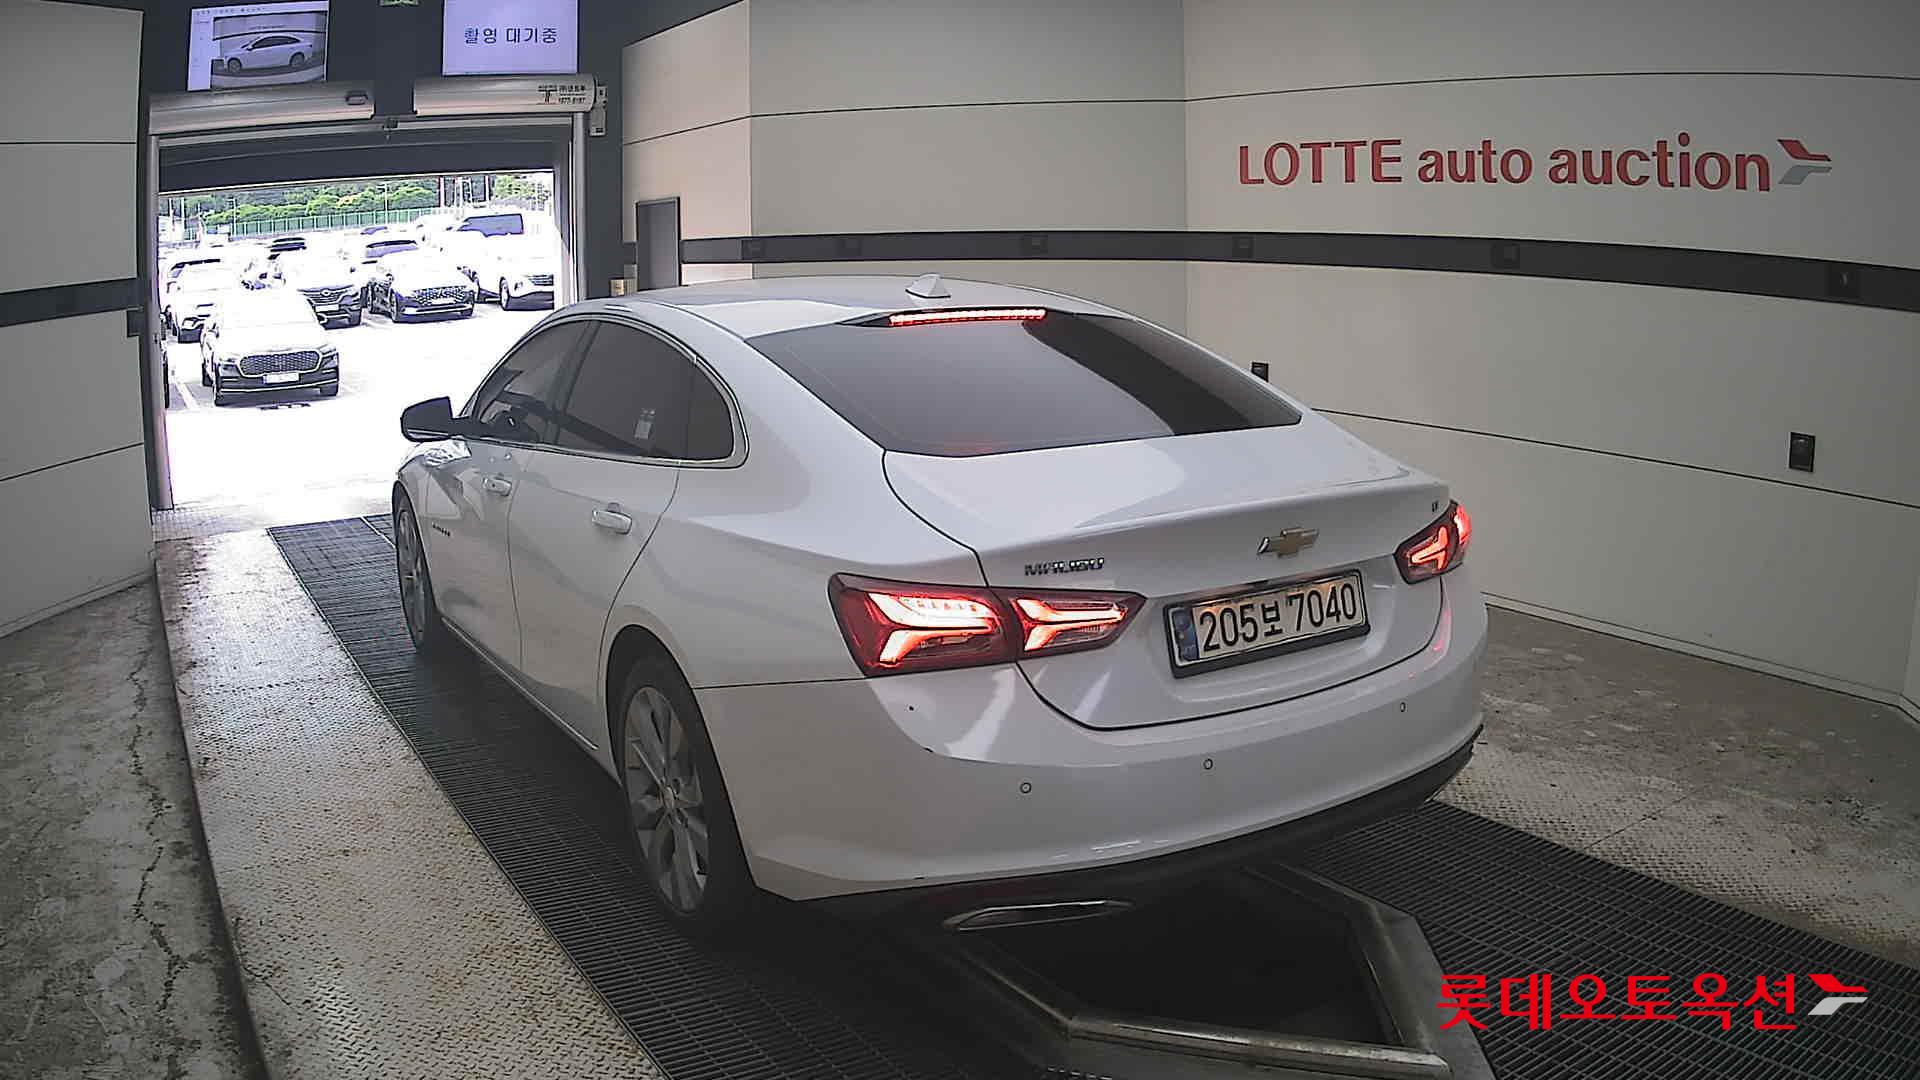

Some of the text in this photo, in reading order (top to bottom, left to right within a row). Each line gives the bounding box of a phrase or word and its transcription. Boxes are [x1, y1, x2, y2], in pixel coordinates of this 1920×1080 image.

[506, 27, 558, 44] 대기중
[1239, 133, 1771, 192] LOTTE auto auction
